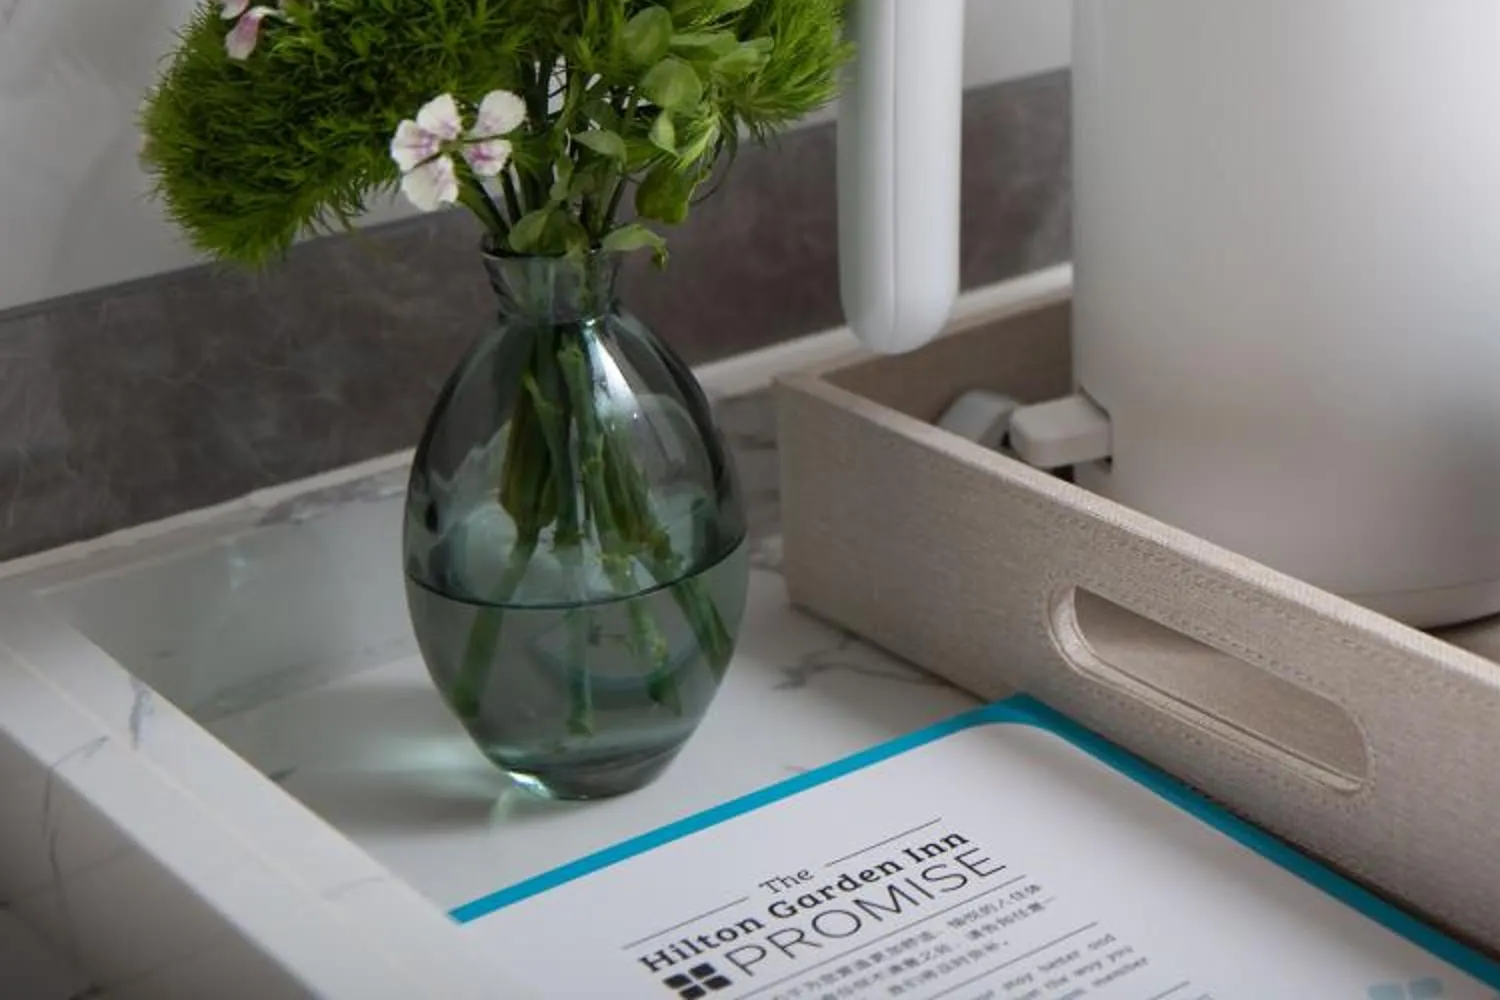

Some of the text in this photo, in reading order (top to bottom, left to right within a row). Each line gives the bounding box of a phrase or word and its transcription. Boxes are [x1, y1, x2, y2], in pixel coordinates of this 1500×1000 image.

[638, 832, 970, 973] Hilton Garden Inn
[723, 847, 1007, 977] PROMISE
[758, 868, 815, 895] The
